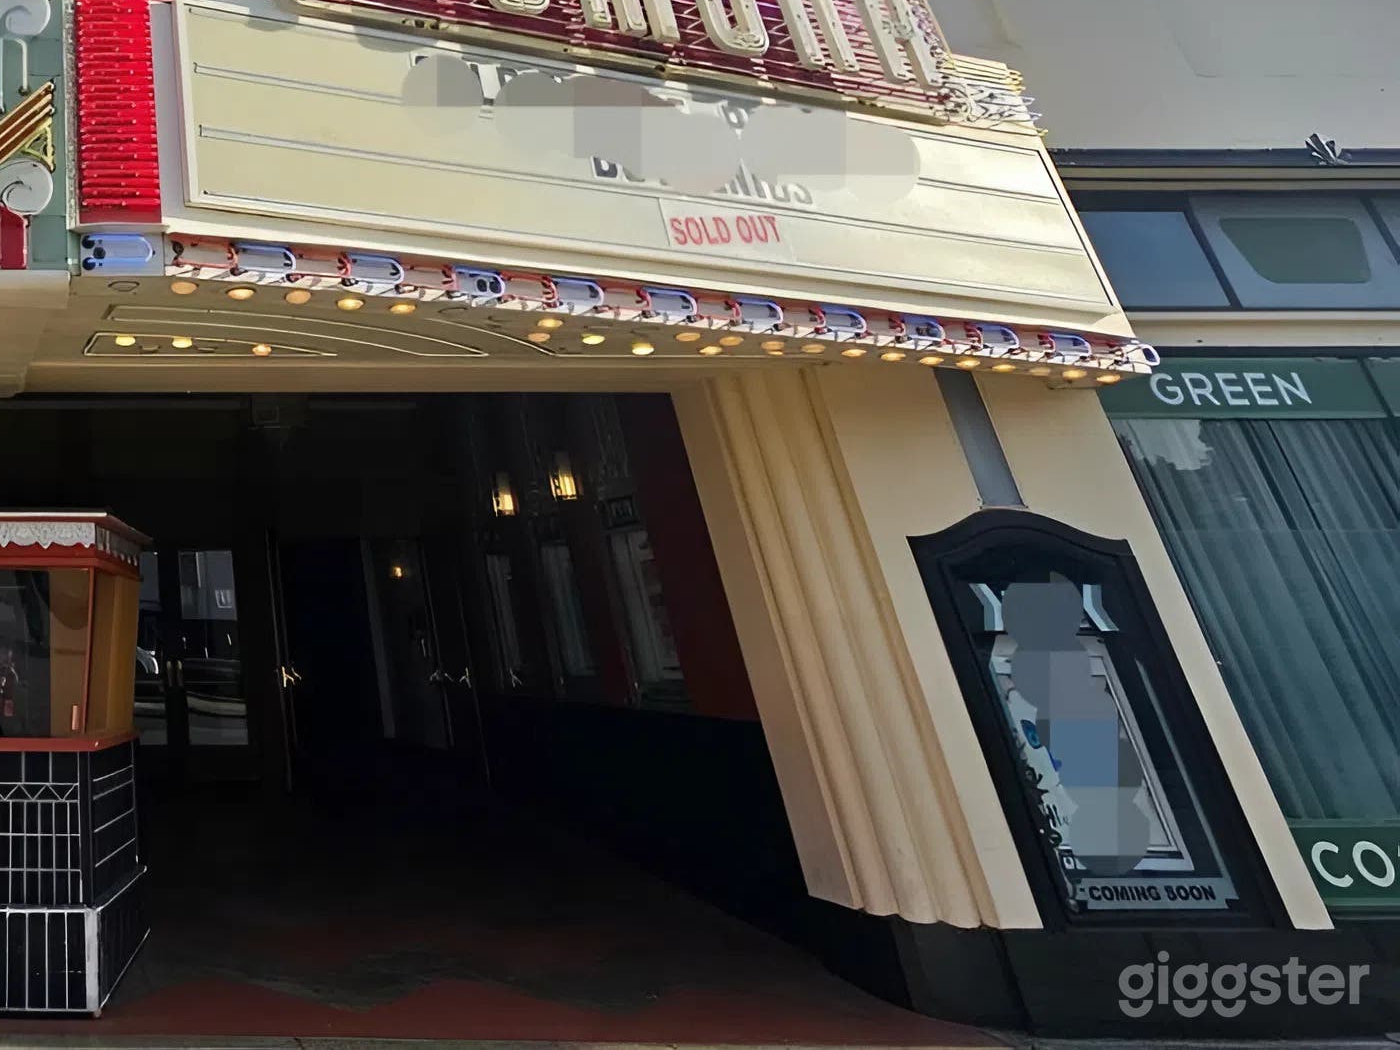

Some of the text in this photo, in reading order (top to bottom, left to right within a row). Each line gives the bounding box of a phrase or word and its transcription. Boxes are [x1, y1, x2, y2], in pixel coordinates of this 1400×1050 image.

[669, 214, 782, 247] SOLD OUT
[1150, 372, 1313, 406] GREEN
[1311, 840, 1400, 888] CO
[1088, 884, 1161, 902] COMING
